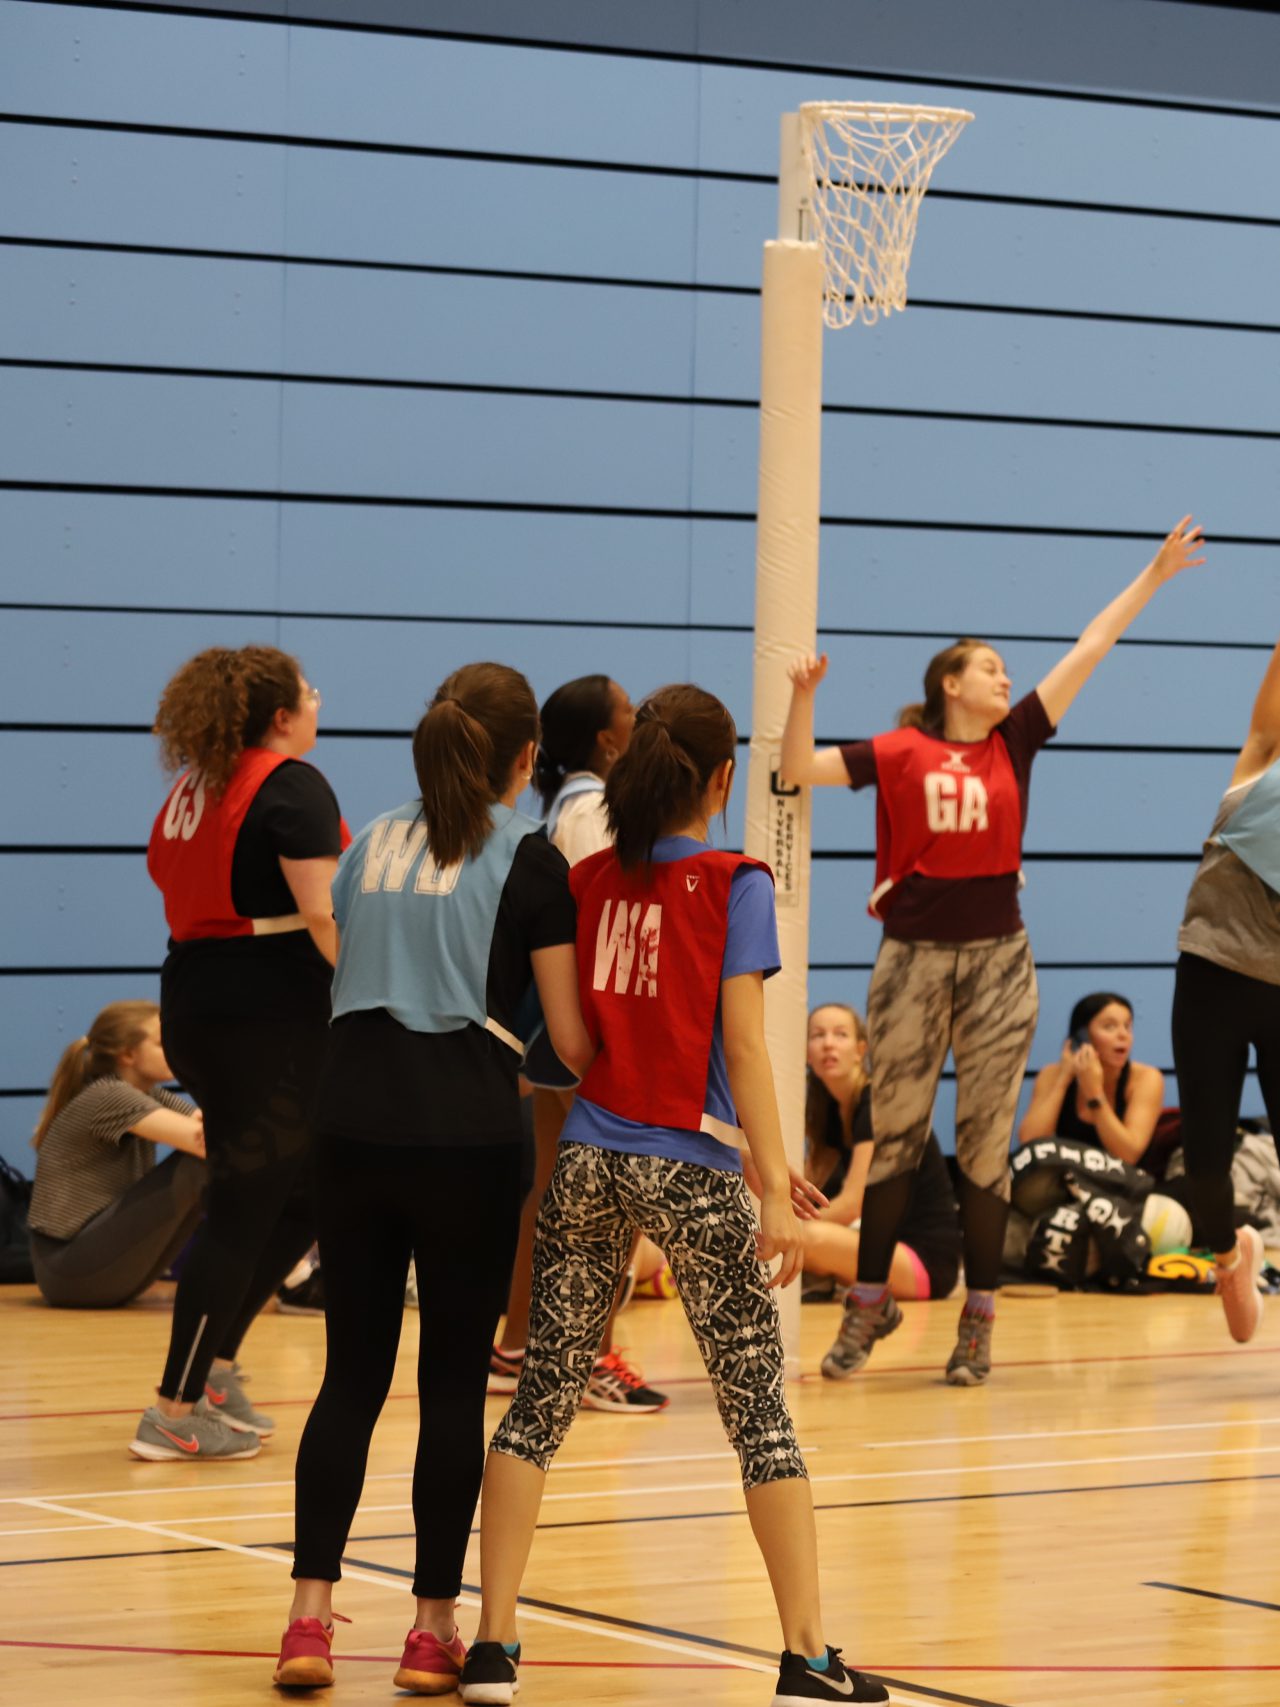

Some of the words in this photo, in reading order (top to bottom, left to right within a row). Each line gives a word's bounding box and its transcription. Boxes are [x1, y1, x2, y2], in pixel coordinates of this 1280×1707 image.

[163, 767, 207, 841] GS
[924, 771, 989, 833] GA
[593, 899, 662, 997] WA
